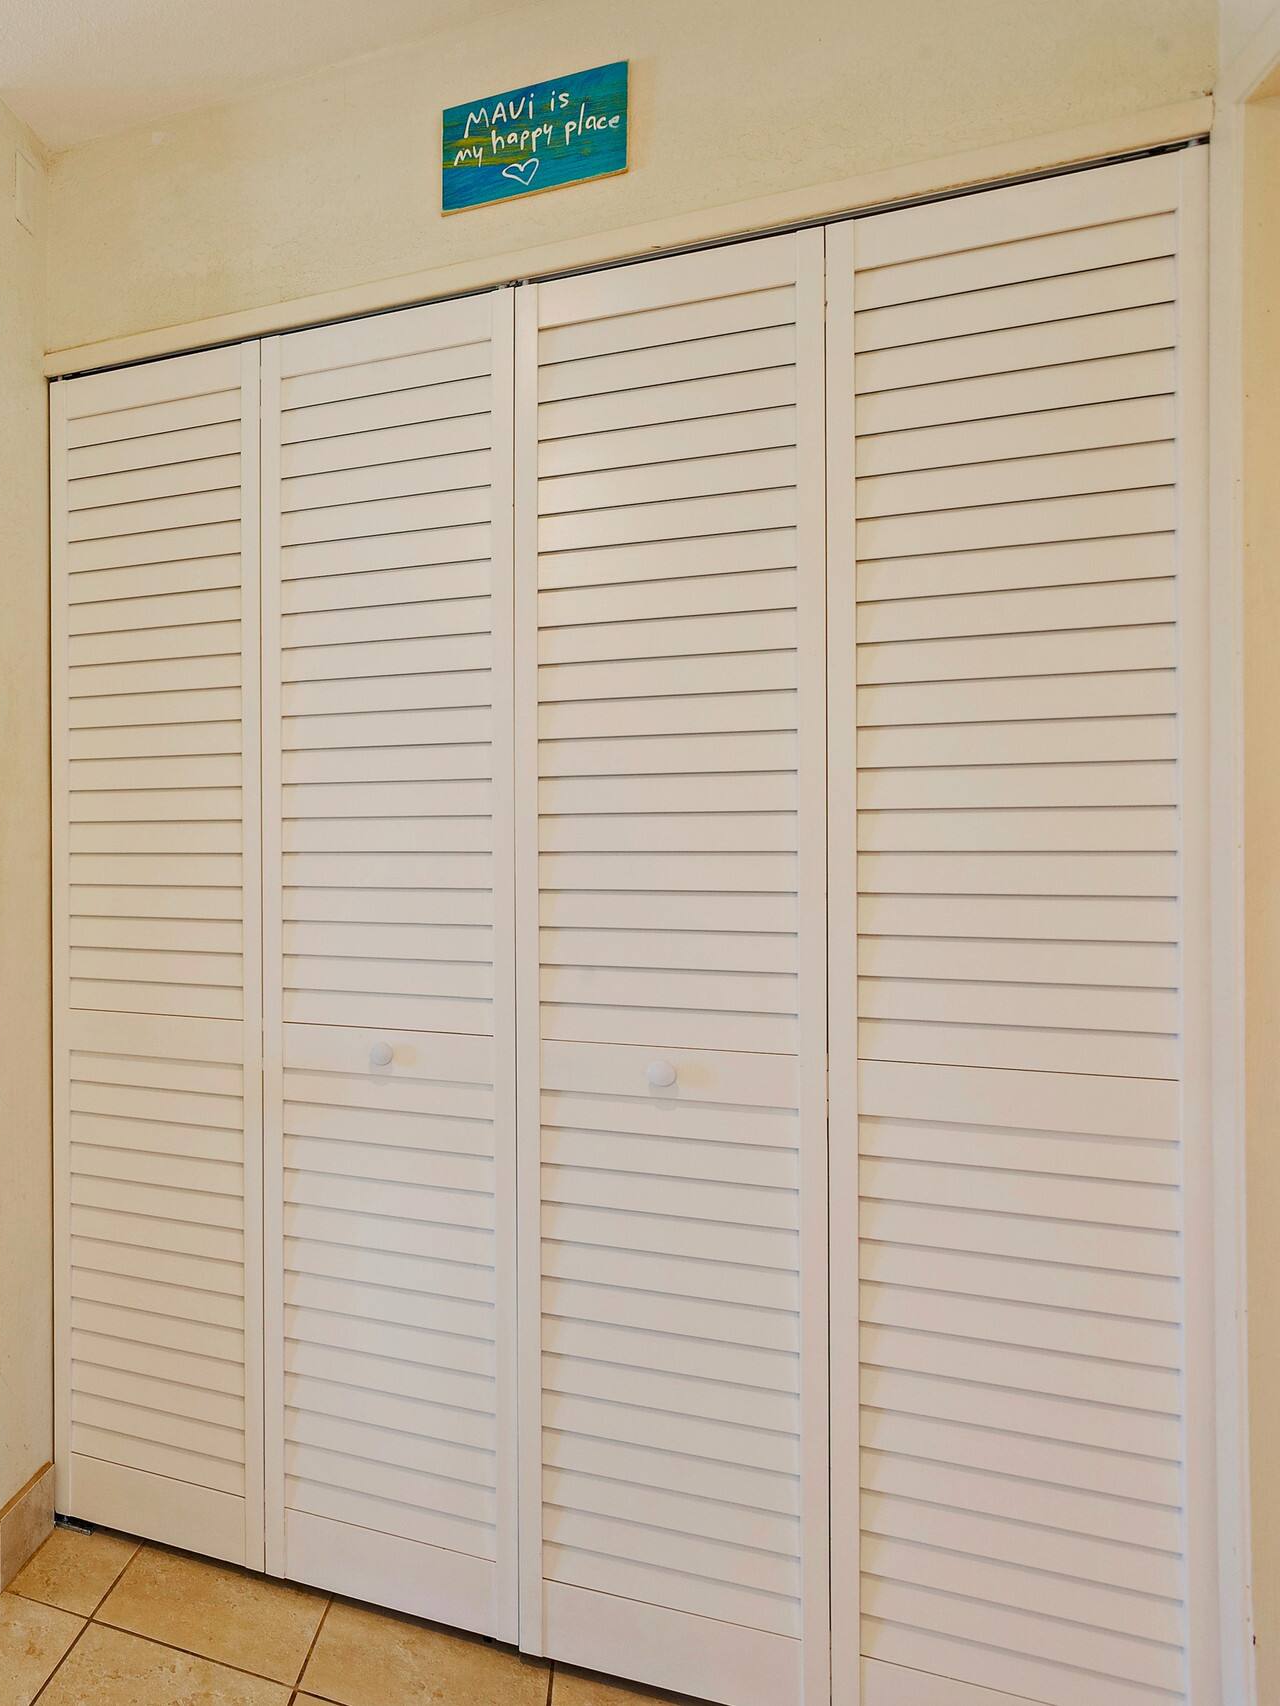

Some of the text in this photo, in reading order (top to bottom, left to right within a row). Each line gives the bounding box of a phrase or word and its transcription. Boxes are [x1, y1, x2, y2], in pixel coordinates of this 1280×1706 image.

[550, 90, 570, 112] is
[453, 102, 620, 168] my happy place
